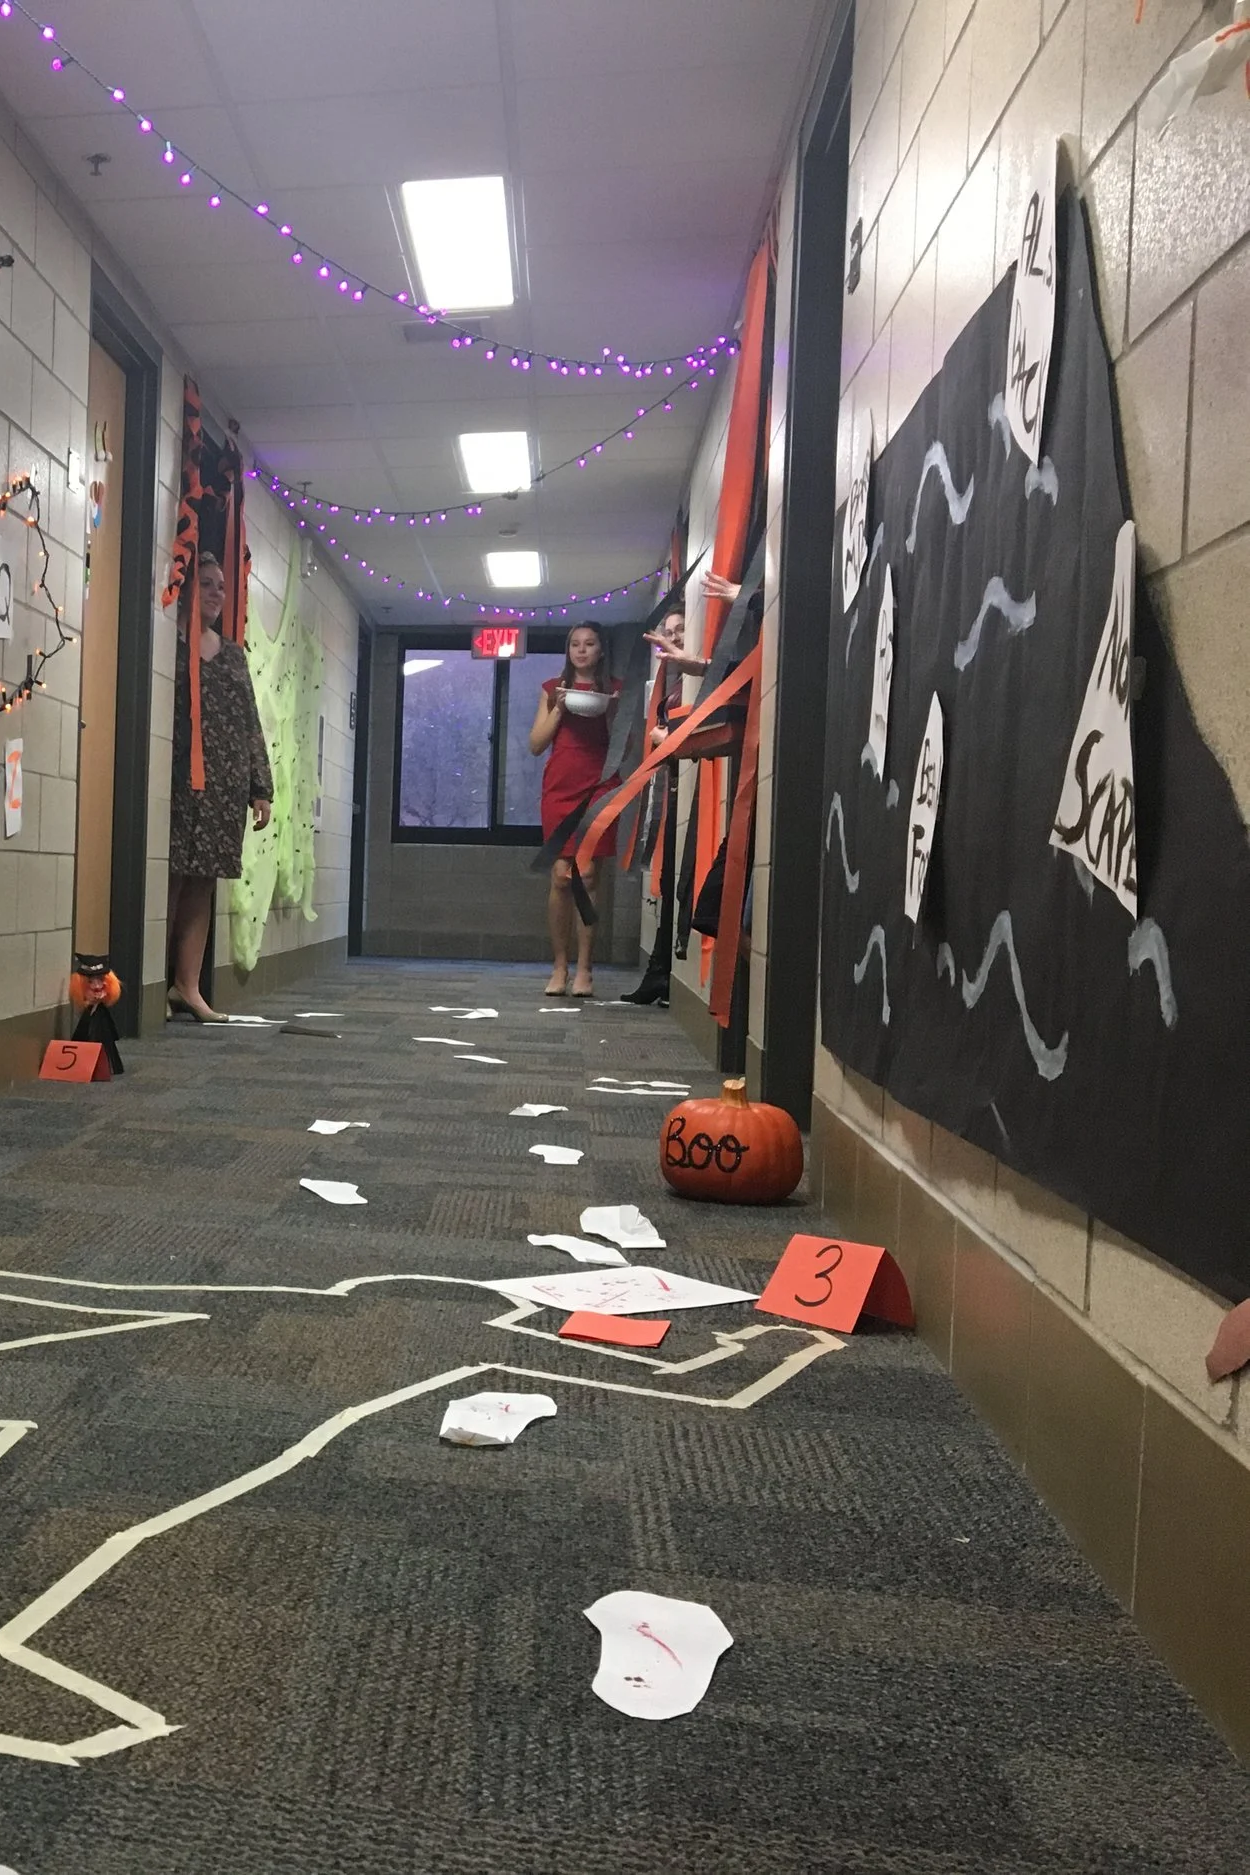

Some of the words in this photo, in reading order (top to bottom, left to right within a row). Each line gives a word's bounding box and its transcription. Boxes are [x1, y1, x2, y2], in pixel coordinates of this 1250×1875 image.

[482, 629, 518, 657] EXIT
[56, 1046, 78, 1070] 5
[795, 1244, 843, 1307] 3
